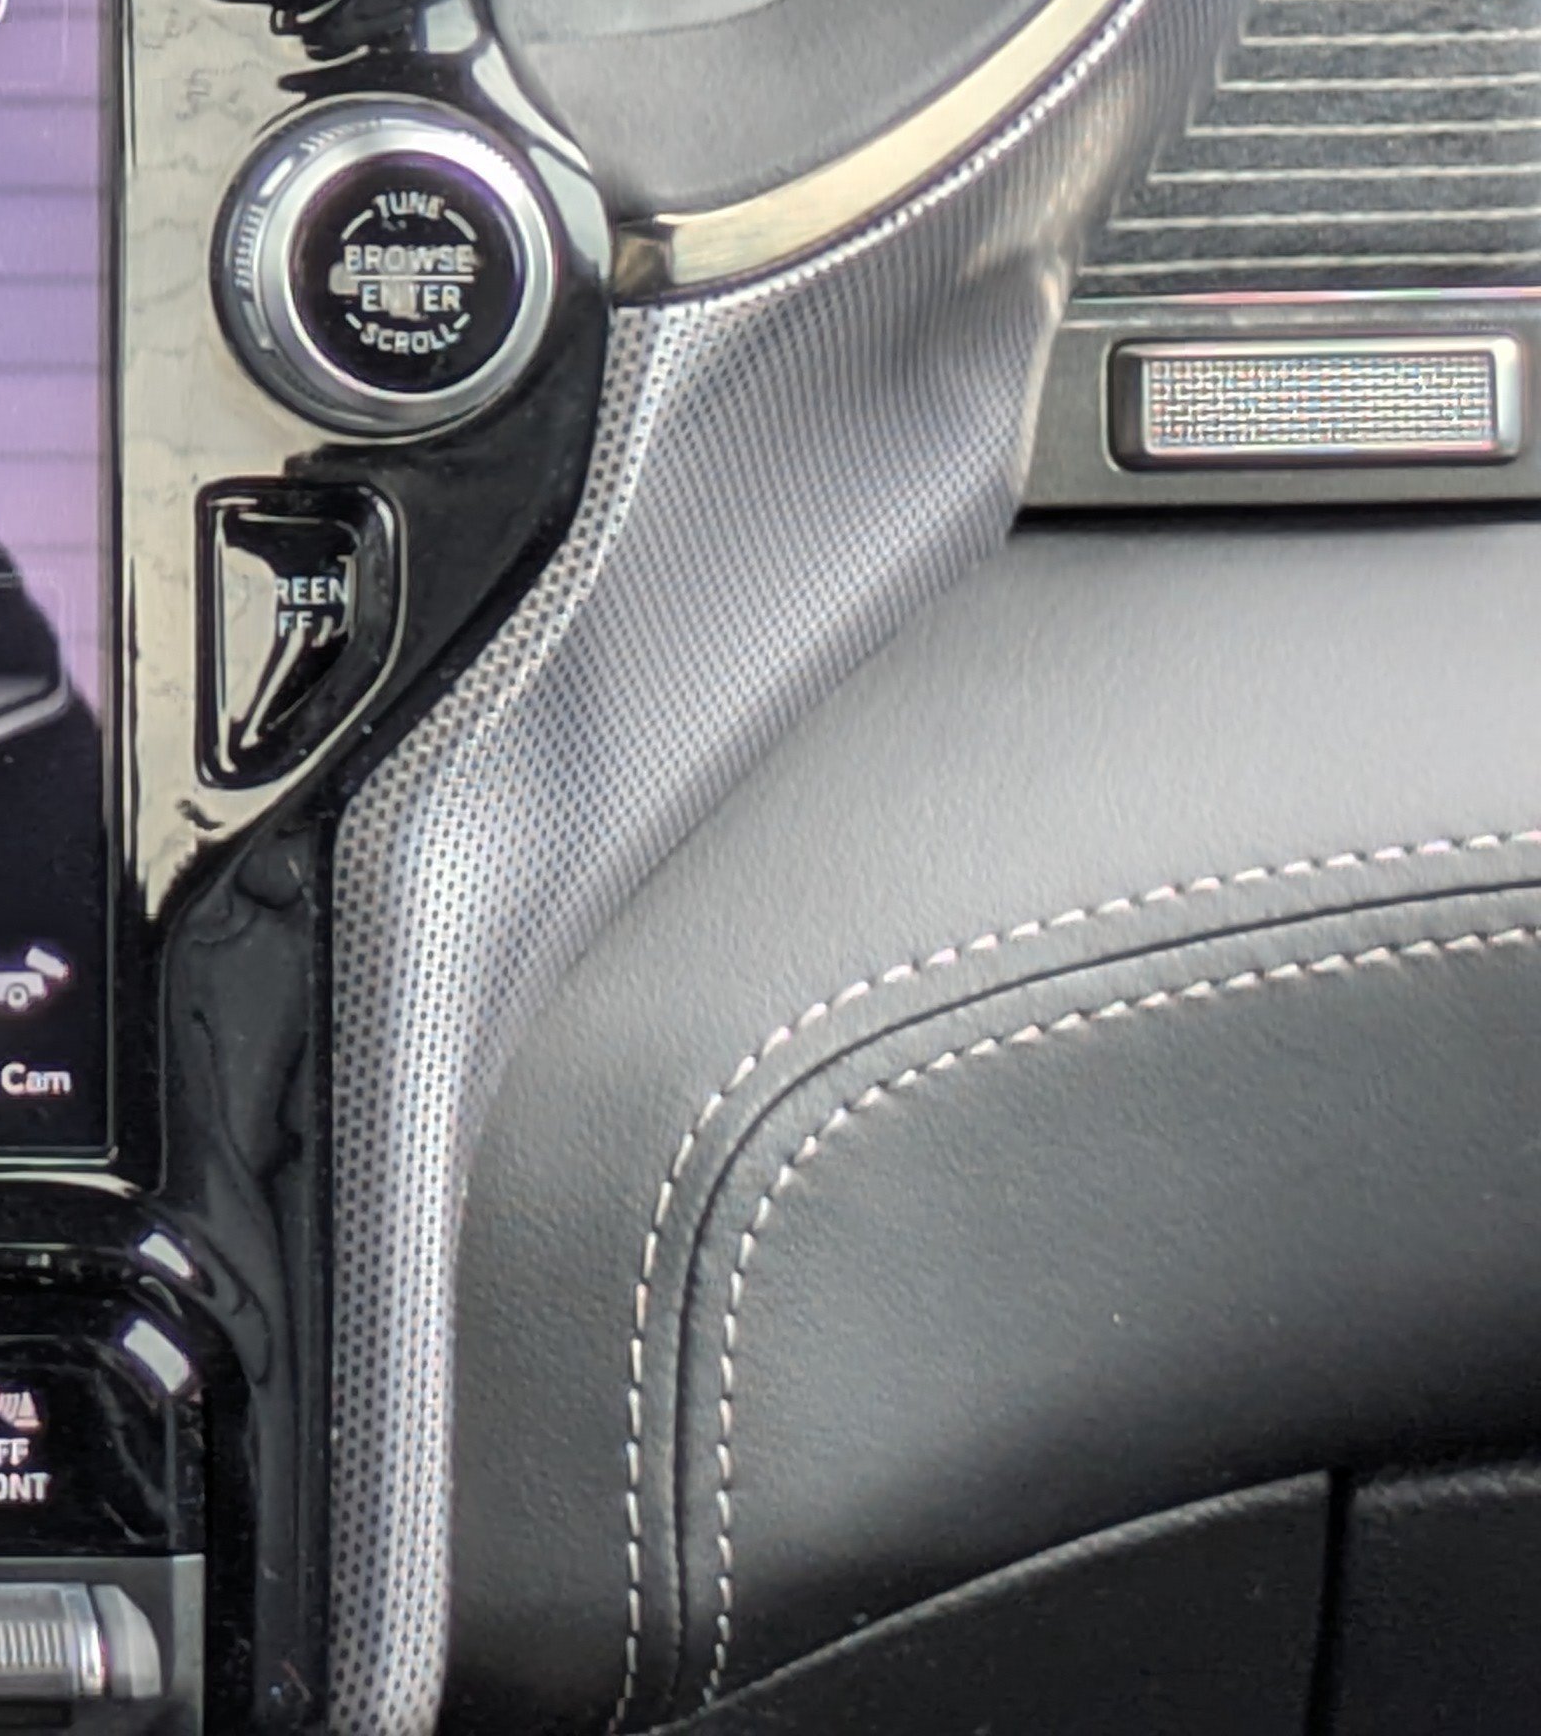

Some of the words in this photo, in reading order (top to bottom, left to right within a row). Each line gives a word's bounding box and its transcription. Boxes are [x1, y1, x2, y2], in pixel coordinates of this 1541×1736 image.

[372, 191, 445, 220] TUNE
[344, 244, 476, 273] BROWSE
[360, 322, 460, 356] SCROLL
[274, 576, 349, 605] REEN
[1, 1063, 72, 1095] Cam
